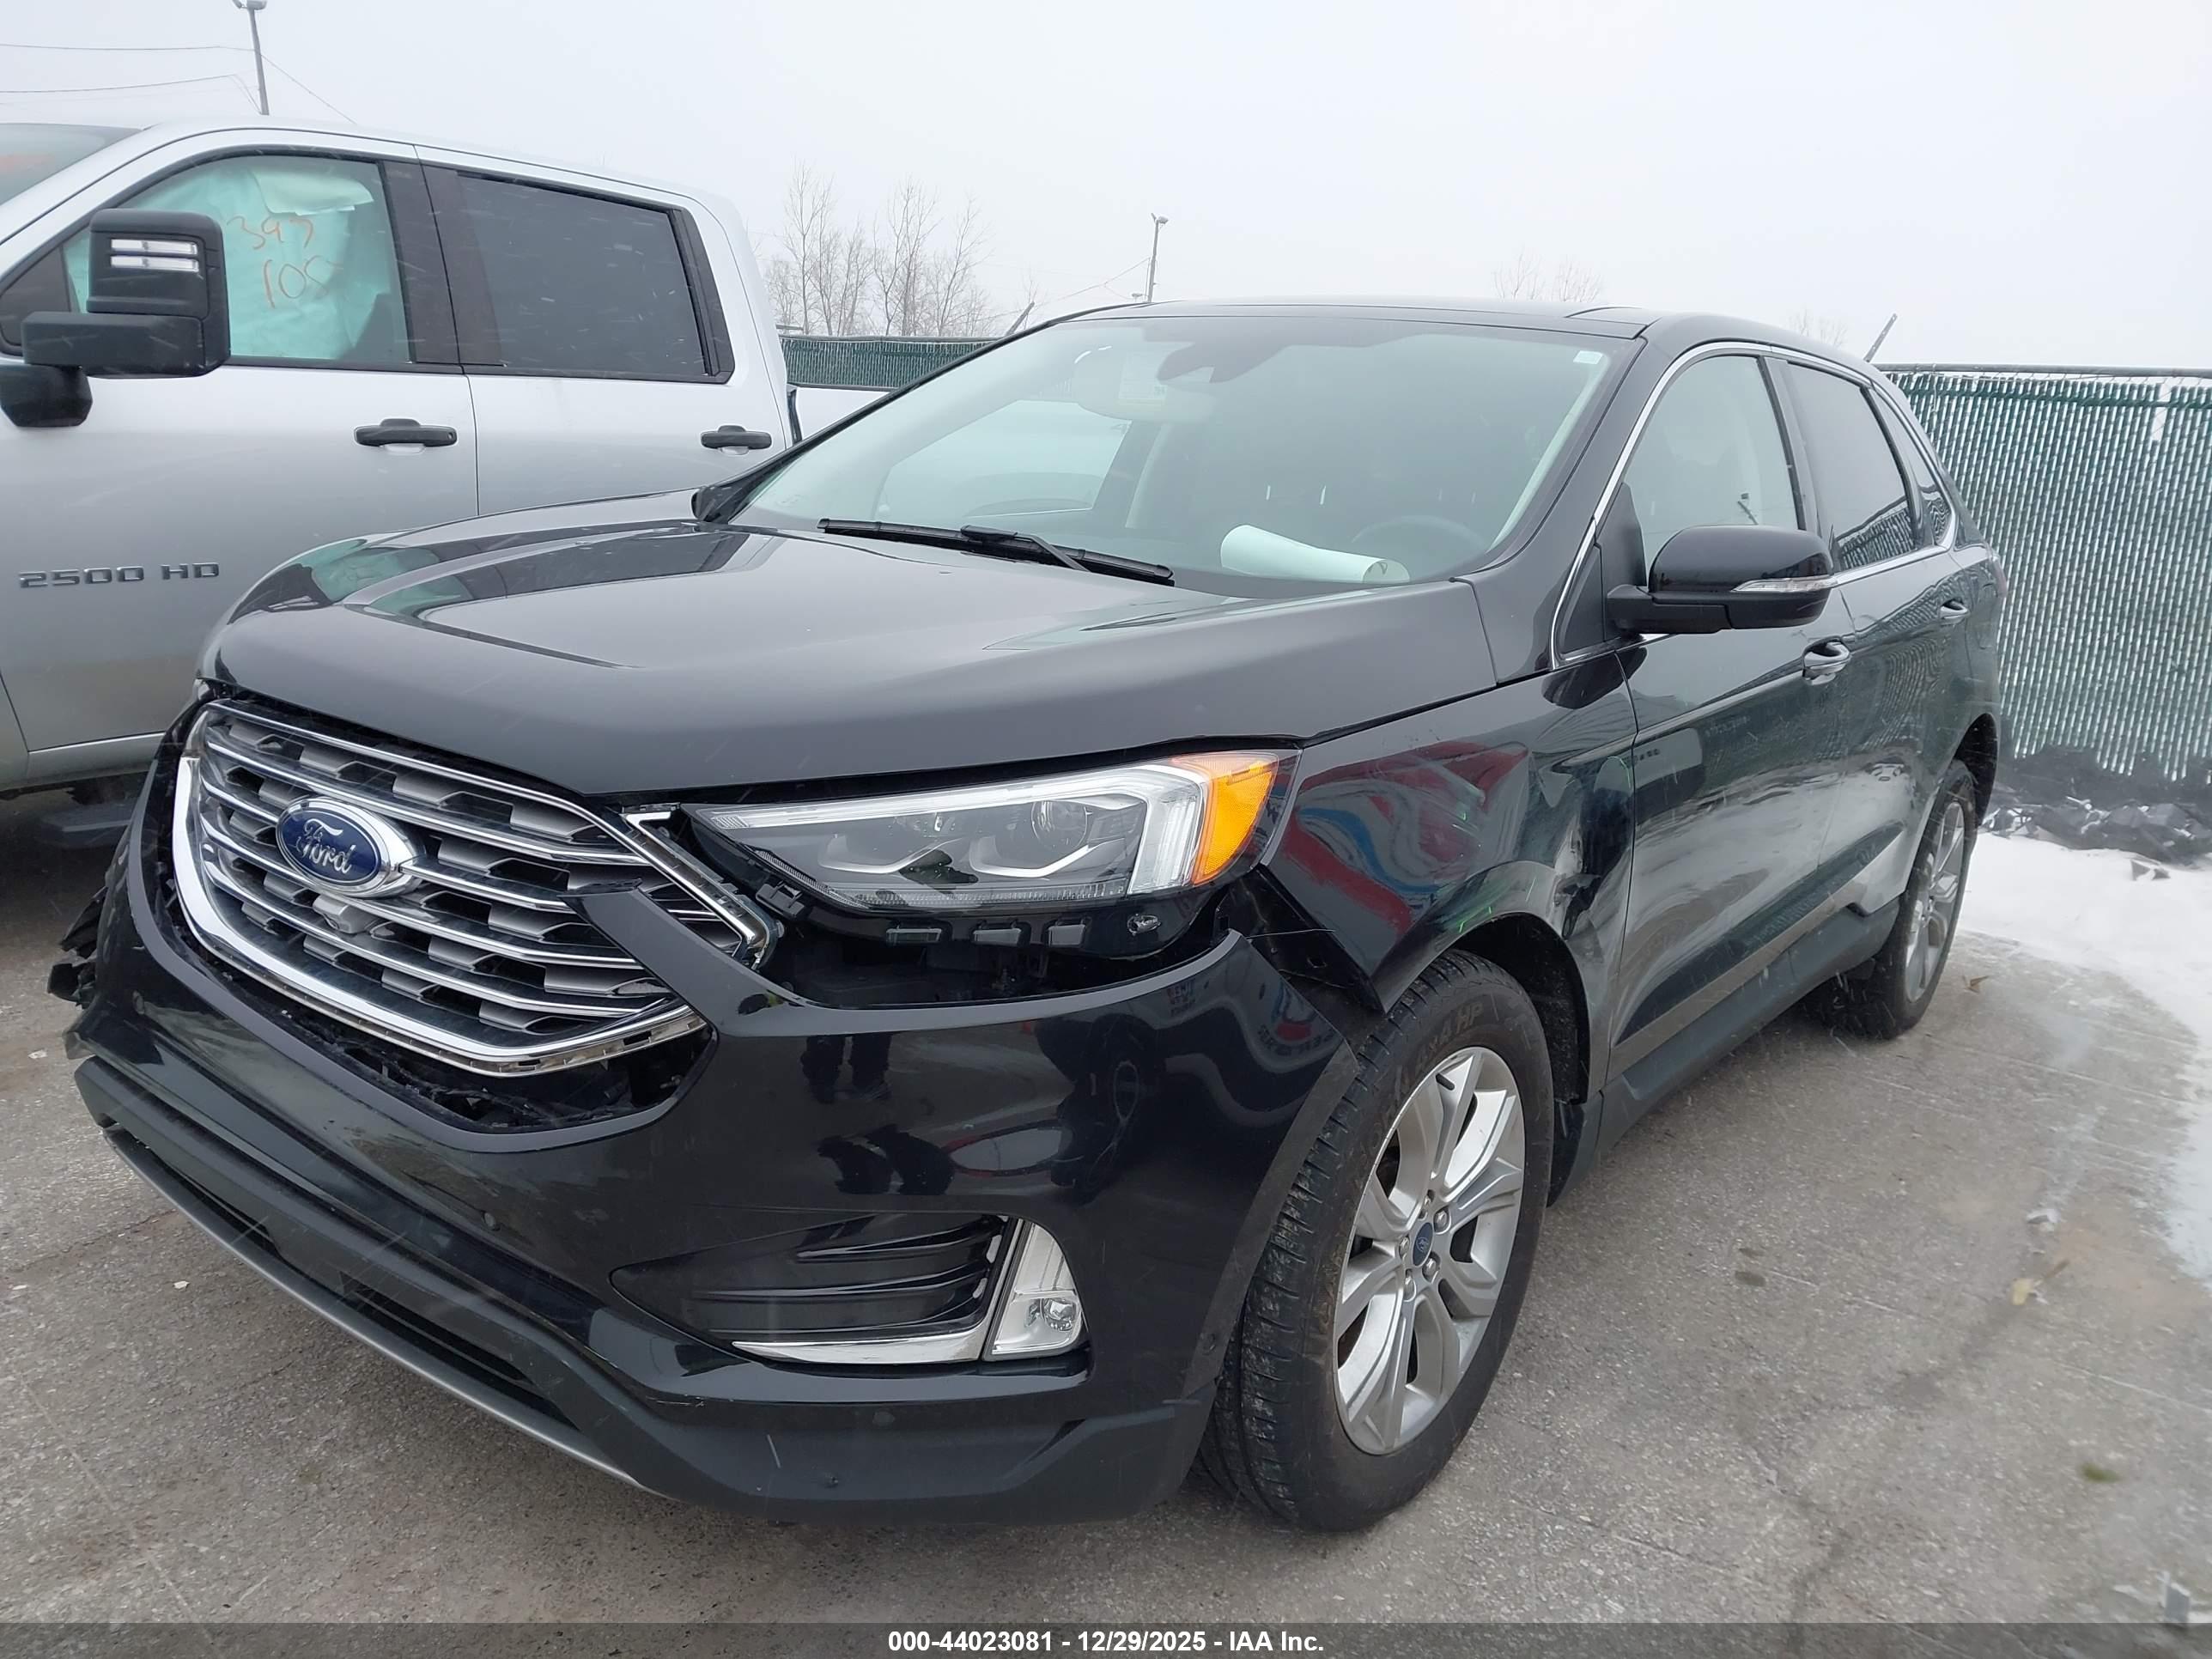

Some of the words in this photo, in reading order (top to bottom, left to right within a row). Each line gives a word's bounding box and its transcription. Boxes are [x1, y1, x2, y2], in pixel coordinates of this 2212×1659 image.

[226, 215, 314, 250] 397
[18, 566, 145, 588] 2500
[161, 562, 220, 580] HD
[295, 817, 357, 874] Ford
